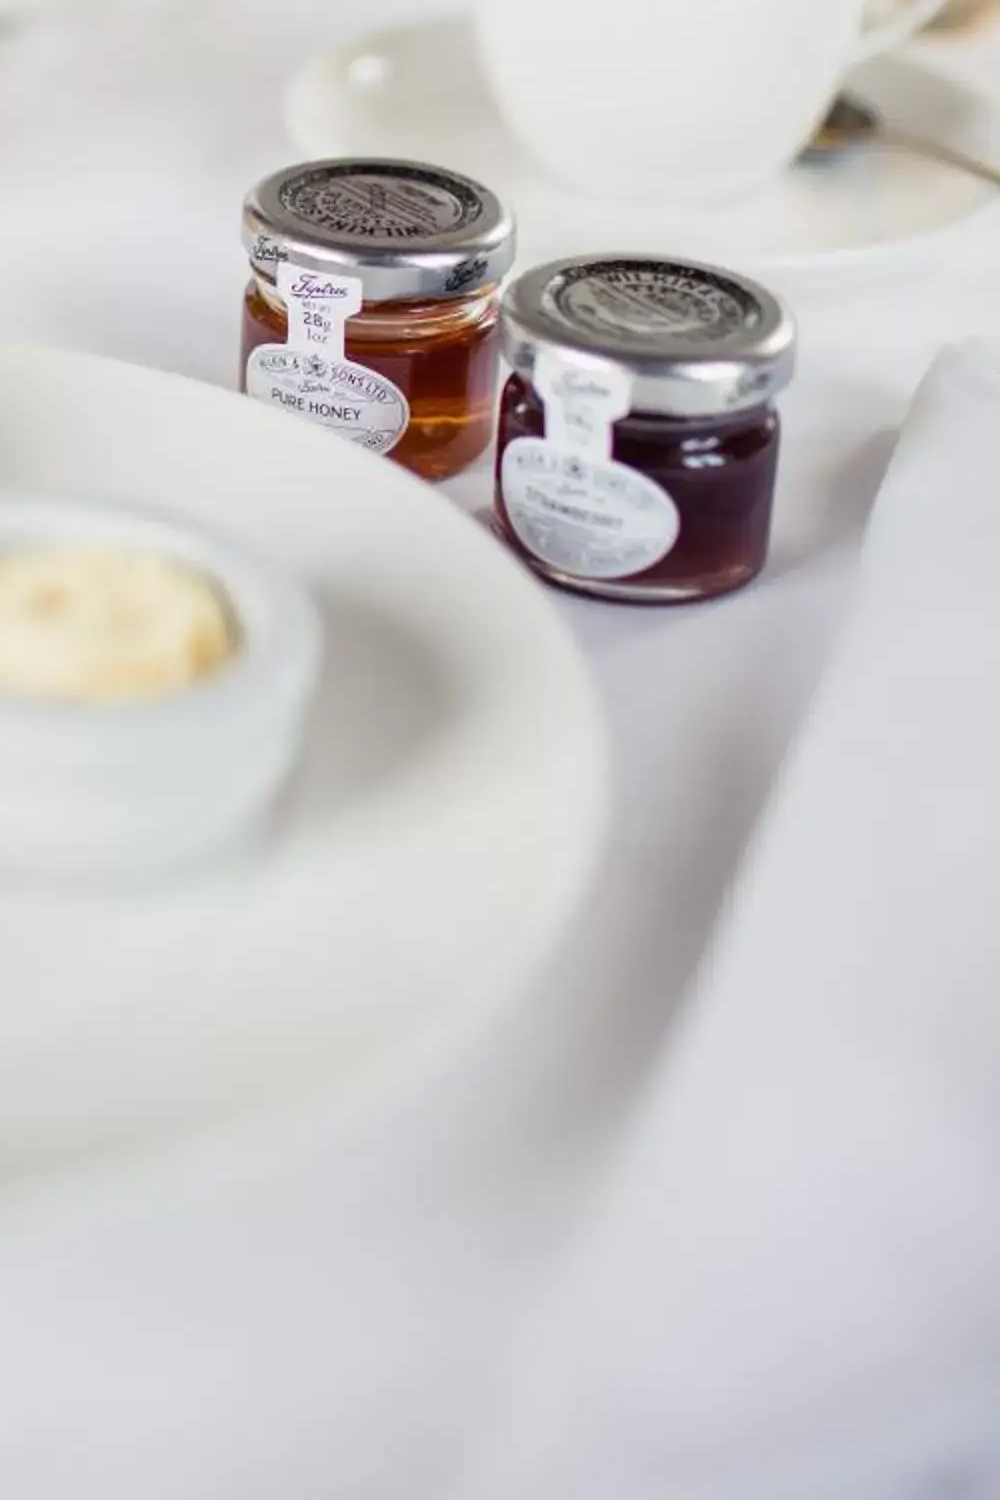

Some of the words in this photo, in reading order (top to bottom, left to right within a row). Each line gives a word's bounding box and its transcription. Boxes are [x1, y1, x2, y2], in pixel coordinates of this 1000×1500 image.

[290, 274, 349, 299] Tiptree
[365, 381, 387, 400] LTD
[271, 387, 305, 411] PURE
[309, 402, 361, 421] HONEY
